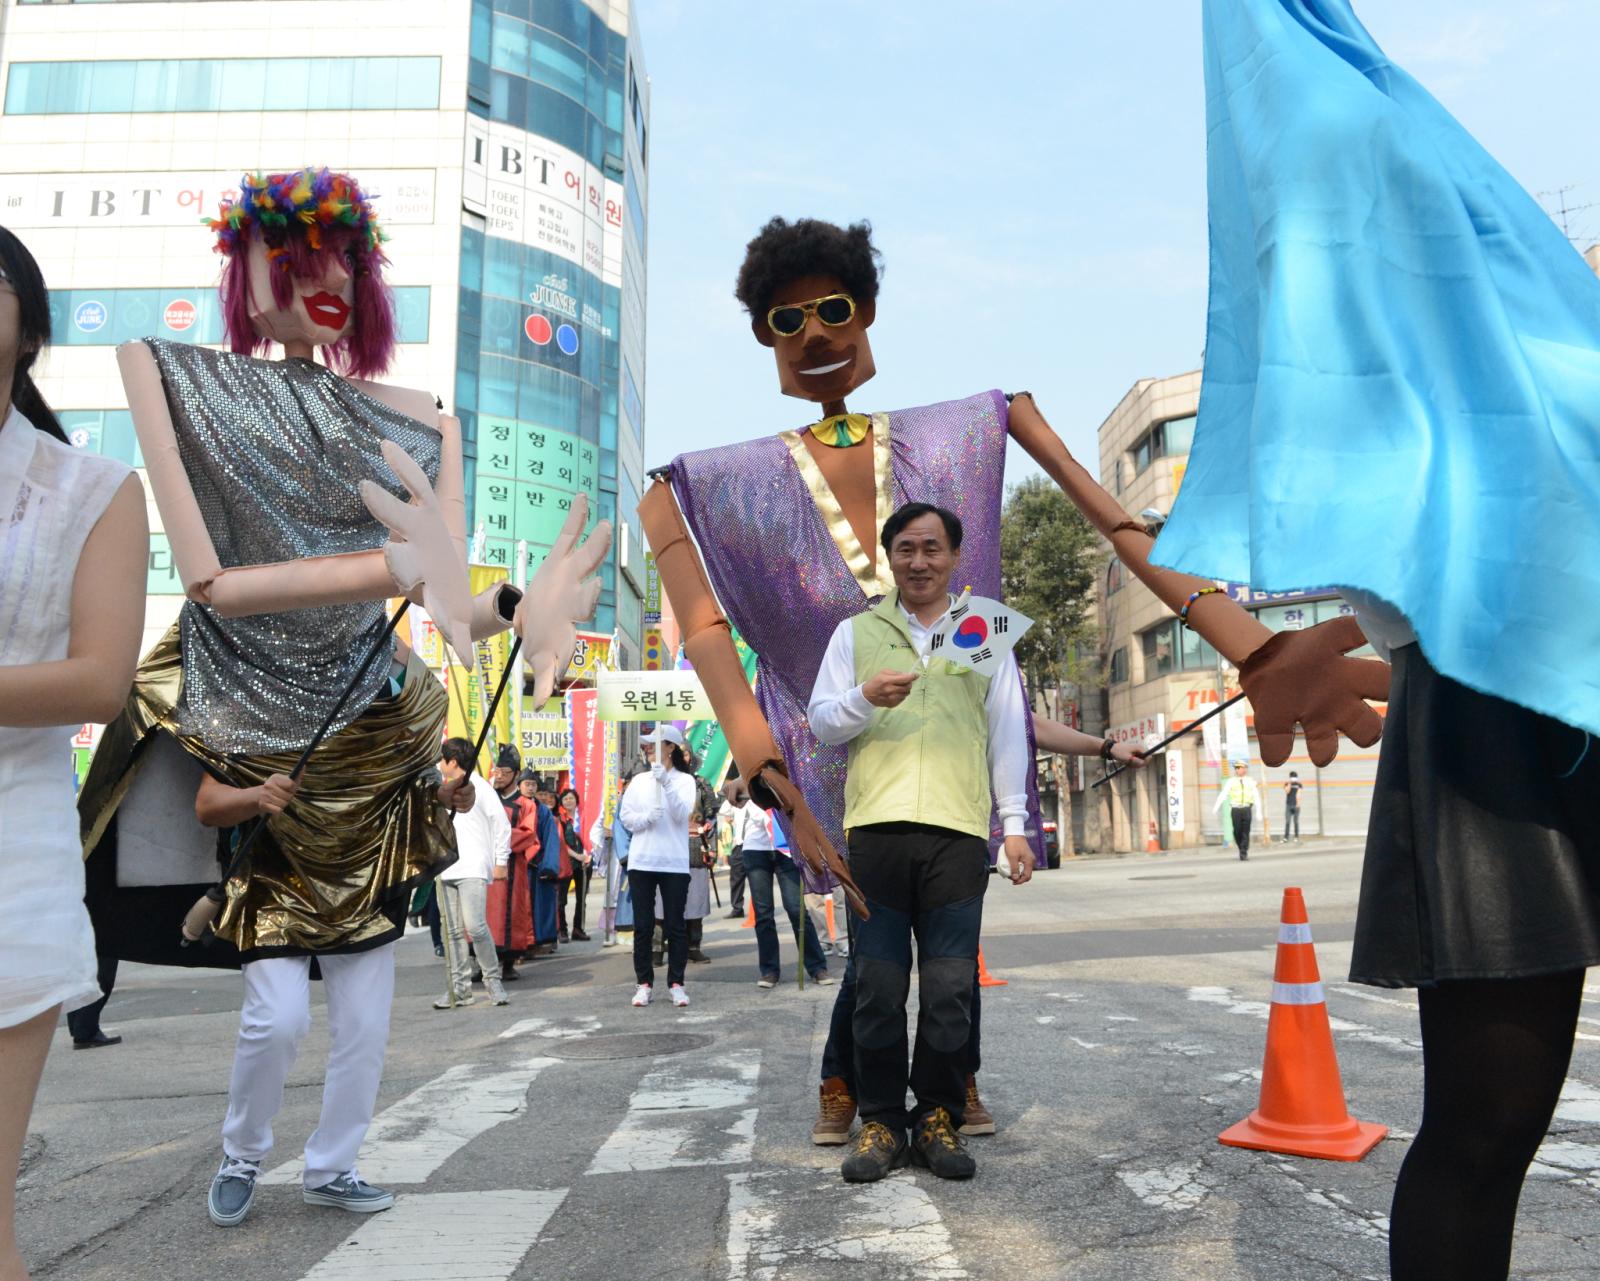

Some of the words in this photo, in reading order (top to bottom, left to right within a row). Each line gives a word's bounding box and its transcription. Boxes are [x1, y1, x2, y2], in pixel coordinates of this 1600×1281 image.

[473, 138, 555, 185] IBT
[564, 170, 622, 228] 어학원
[491, 189, 519, 205] TOEIC
[50, 188, 162, 217] IBT
[490, 203, 520, 219] TOEFL
[490, 425, 593, 464] 정형외과
[488, 453, 593, 492] 신경외과
[621, 690, 658, 712] 옥련
[665, 690, 697, 711] 1동
